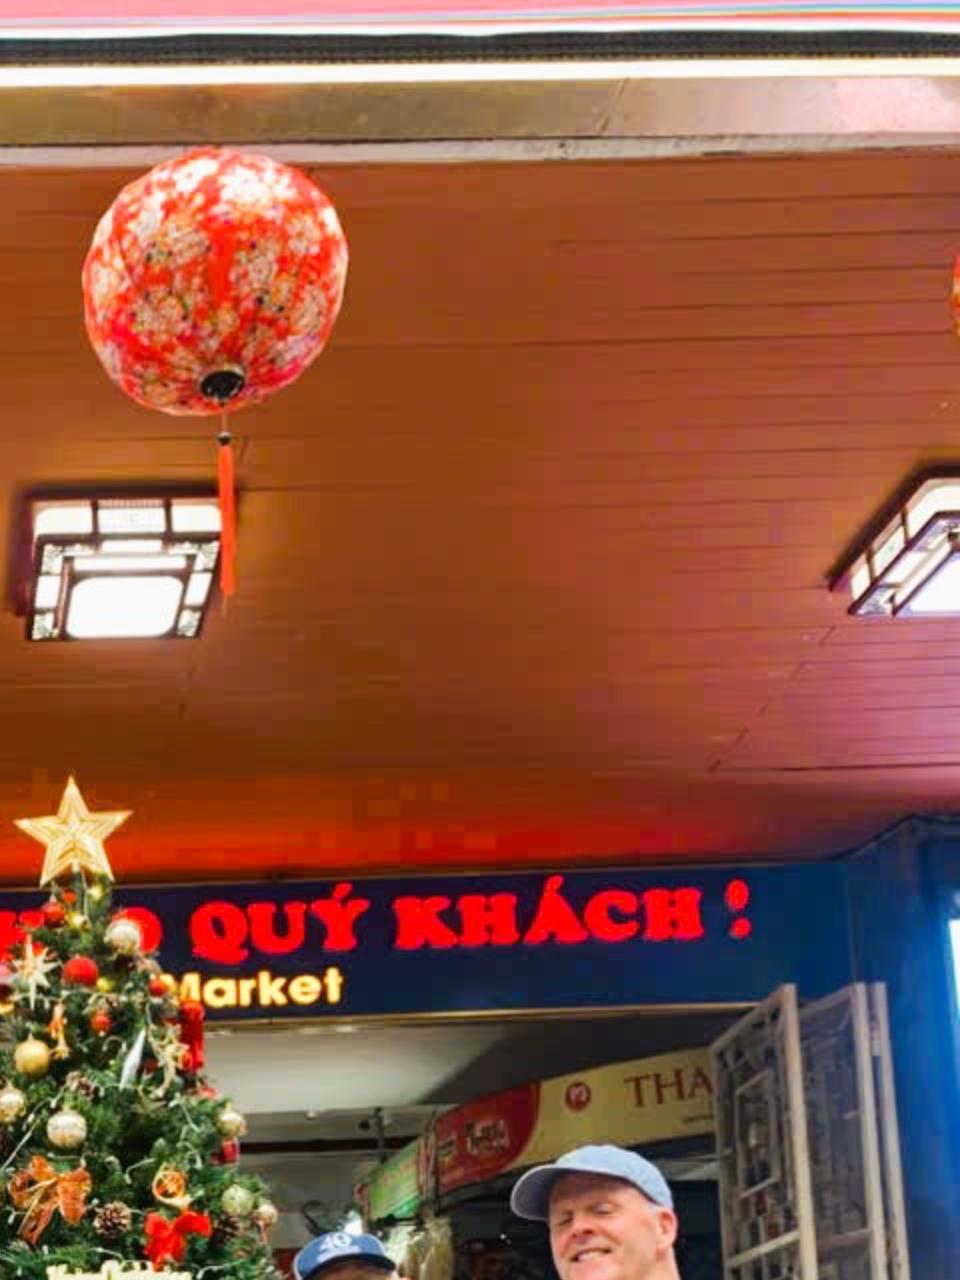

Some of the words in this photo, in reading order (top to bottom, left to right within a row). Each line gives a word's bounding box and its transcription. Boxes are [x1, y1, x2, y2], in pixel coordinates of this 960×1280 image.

[190, 882, 370, 964] QUÝ
[392, 875, 704, 950] KHÁCH
[725, 880, 750, 937] !
